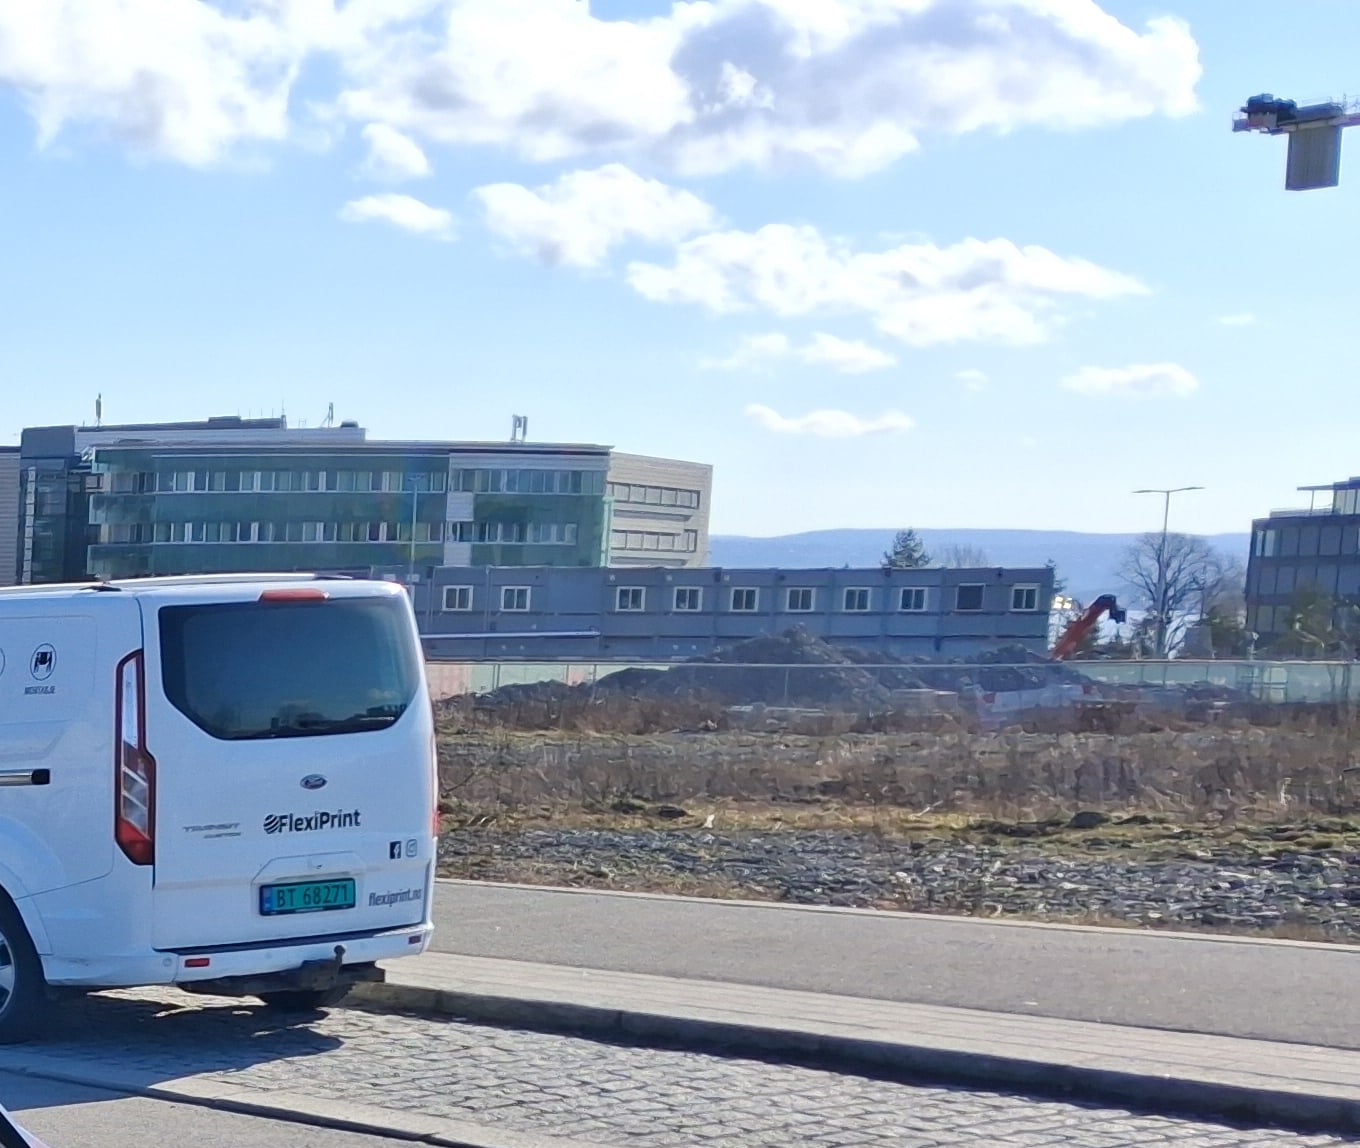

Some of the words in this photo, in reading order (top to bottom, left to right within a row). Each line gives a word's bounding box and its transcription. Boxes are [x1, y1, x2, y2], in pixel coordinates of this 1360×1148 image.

[277, 808, 361, 834] FlexiPrint
[277, 887, 296, 908] BT
[303, 884, 349, 906] 68271
